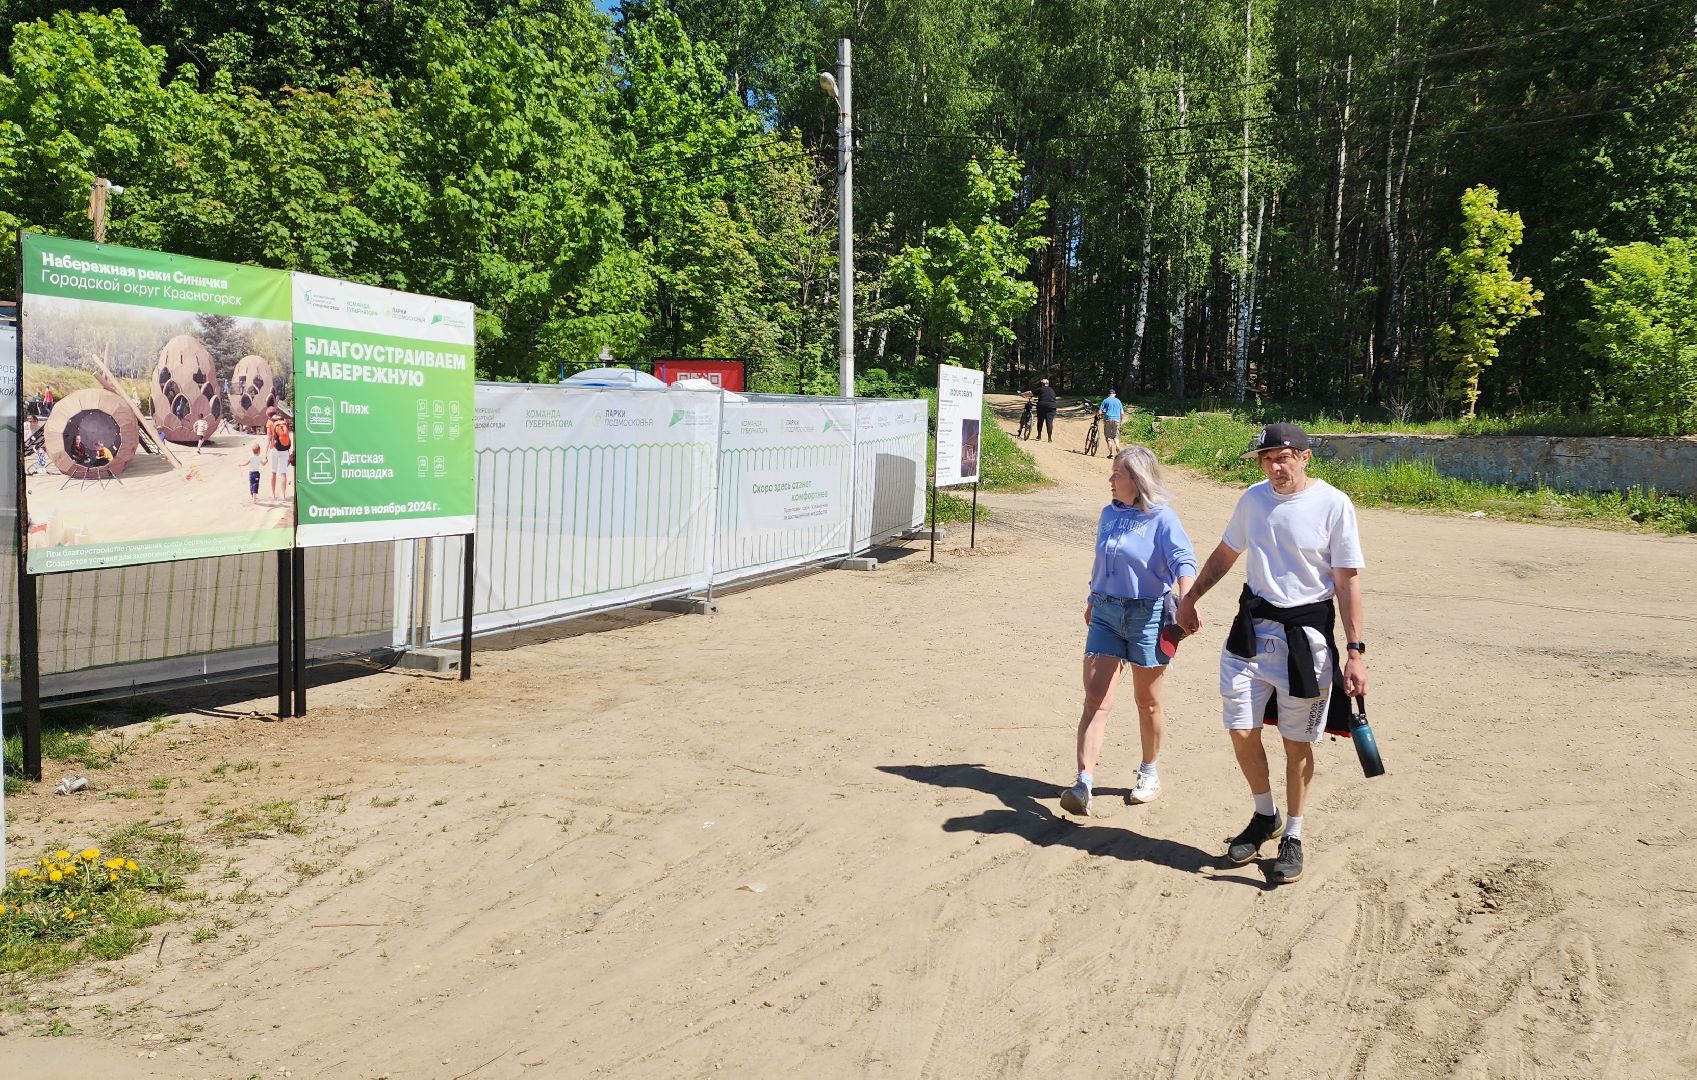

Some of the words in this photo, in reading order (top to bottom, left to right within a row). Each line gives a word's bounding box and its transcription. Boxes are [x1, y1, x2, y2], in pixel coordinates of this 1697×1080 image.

[41, 252, 136, 278] Набережная
[138, 269, 171, 281] реки
[172, 271, 228, 289] Синичка
[41, 269, 120, 292] Городской
[123, 283, 161, 298] округ
[163, 285, 242, 306] Красногорск
[305, 336, 466, 370] БЛАГОУСТРАИВАЕМ
[305, 360, 424, 387] НАБЕРЕЖНУЮ
[340, 401, 369, 415] Пляж
[526, 409, 561, 418] КОМАНДА
[525, 420, 573, 428] ГУБЕРНАТОРА
[604, 418, 653, 427] ПОДМОСКОВЬЯ
[341, 451, 384, 465] Детская
[341, 467, 394, 479] площадка
[752, 483, 773, 494] Скоро
[774, 482, 791, 493] здесь
[792, 481, 812, 490] станет
[308, 504, 363, 518] Открытие
[364, 506, 370, 514] в
[370, 503, 407, 516] ноябре
[407, 501, 432, 512] 2024
[432, 502, 440, 512] г.
